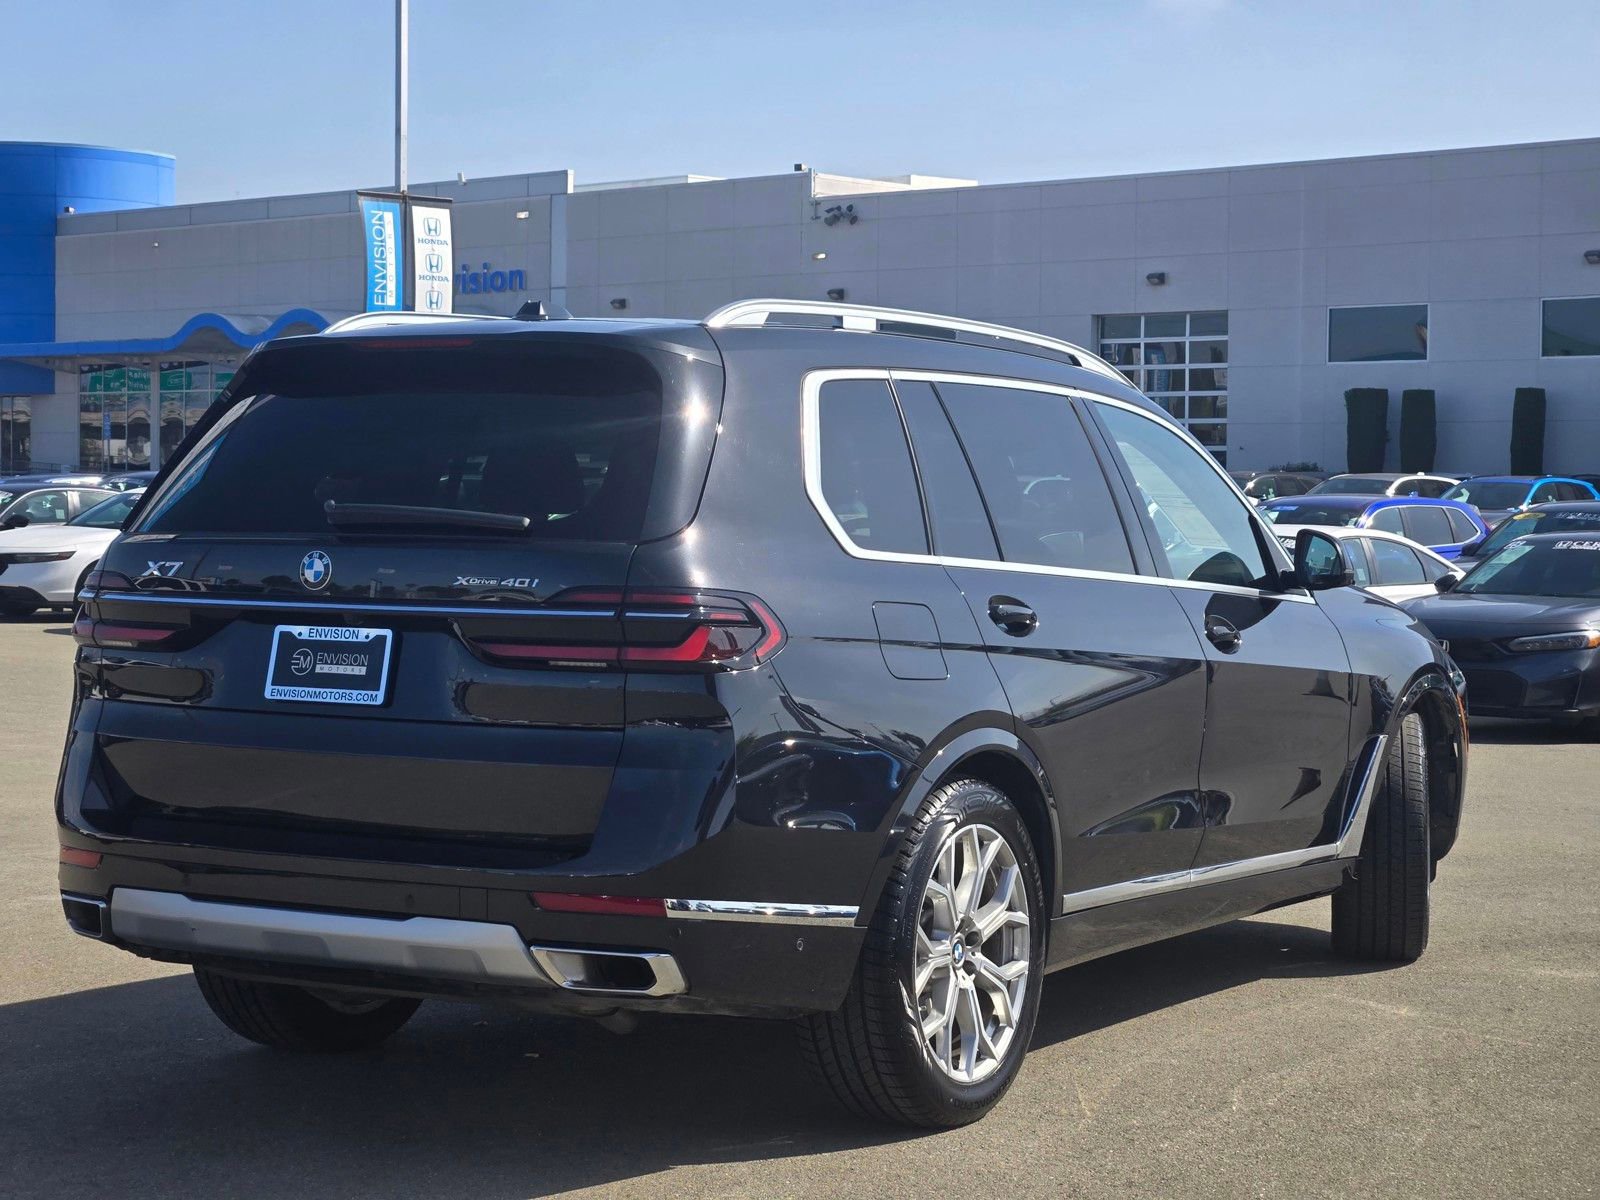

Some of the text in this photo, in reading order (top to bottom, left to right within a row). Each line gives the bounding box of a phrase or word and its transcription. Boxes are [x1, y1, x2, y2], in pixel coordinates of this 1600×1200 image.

[417, 237, 449, 246] HONDA
[370, 210, 386, 306] ENVISION
[418, 273, 450, 282] HONDA
[303, 552, 329, 565] BMW
[141, 560, 184, 577] X7
[308, 628, 360, 640] ENVISION
[316, 652, 369, 666] ENVISION
[319, 666, 363, 674] MOTORS
[270, 688, 378, 702] ENVISIONMOTORS.COM
